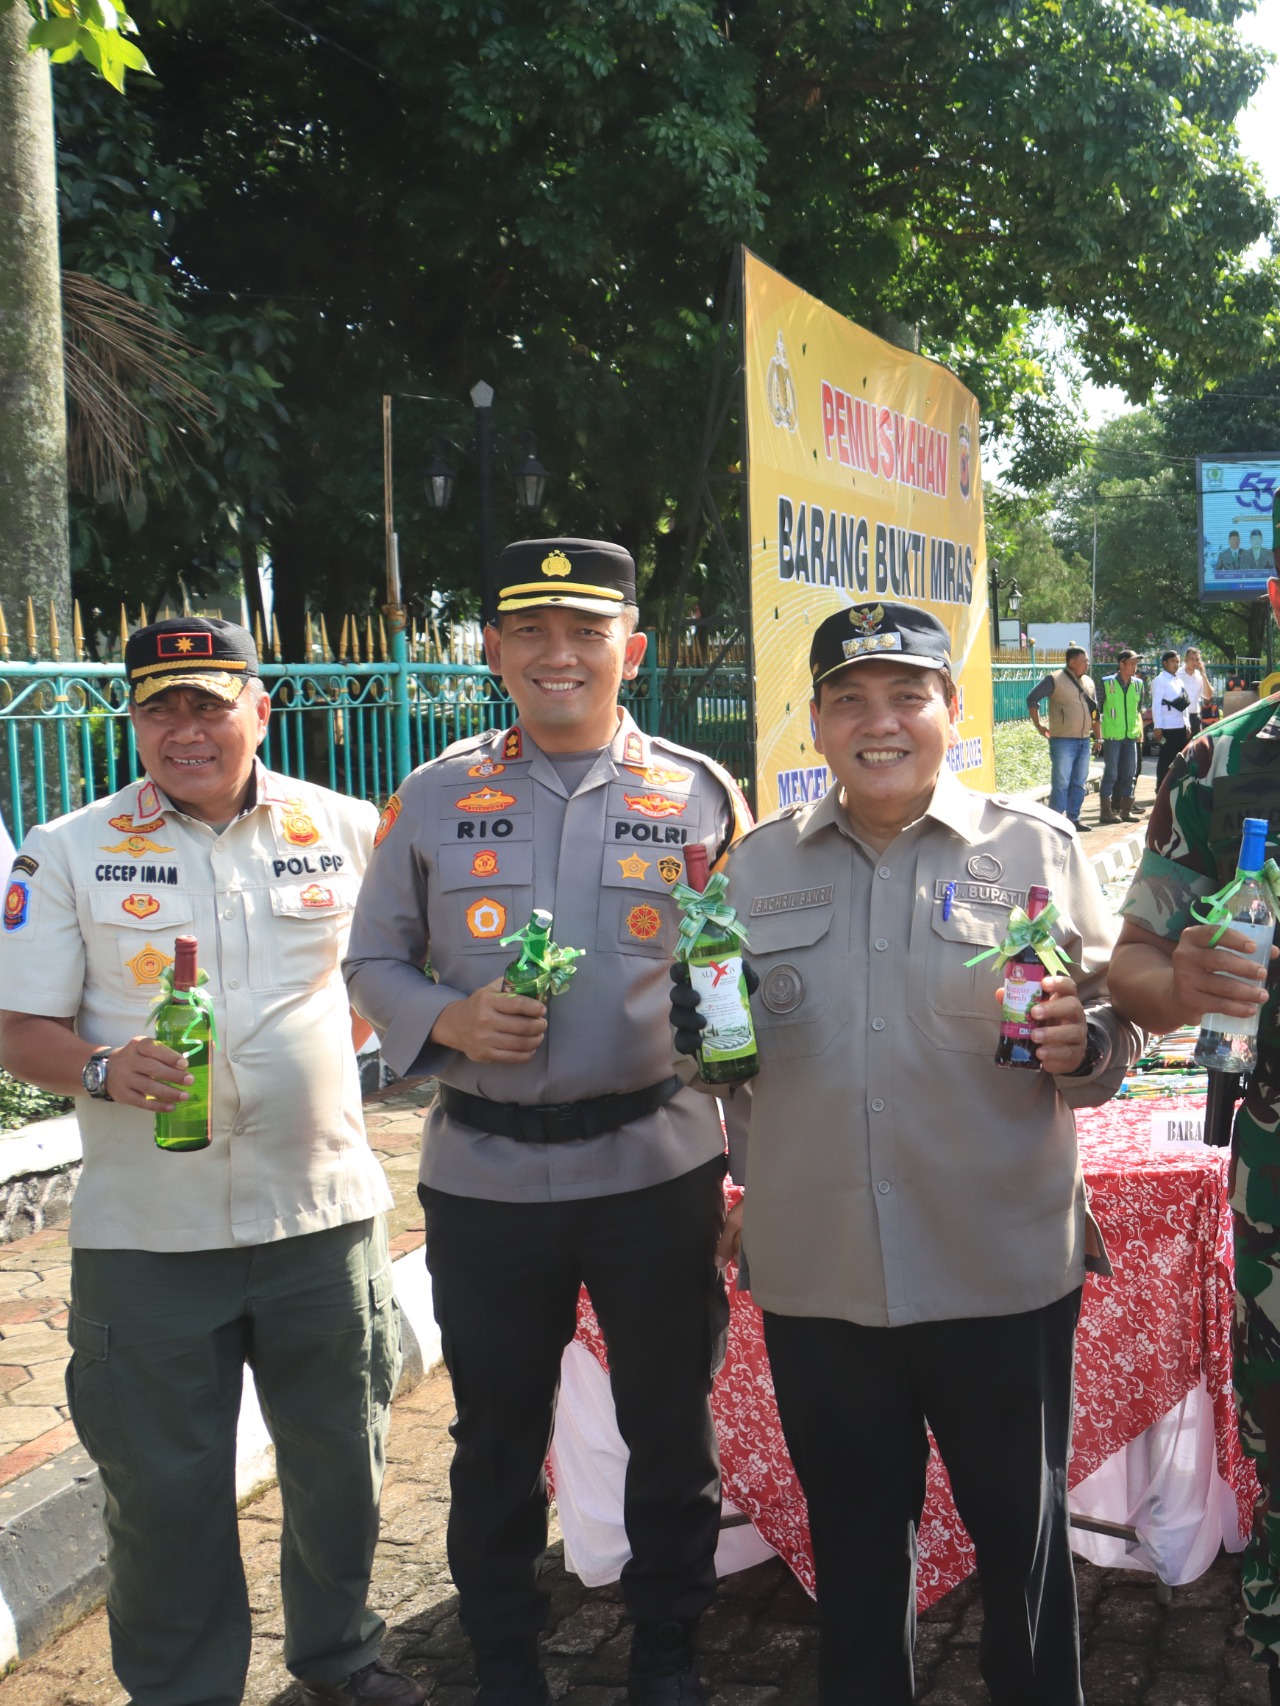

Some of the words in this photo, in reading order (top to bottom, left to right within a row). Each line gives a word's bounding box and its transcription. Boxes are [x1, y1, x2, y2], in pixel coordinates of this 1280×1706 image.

[821, 380, 949, 498] PEMUSNAHAN
[778, 495, 869, 594] BARANG
[875, 522, 927, 599] BUKTI
[930, 536, 973, 605] MIRAS
[965, 738, 982, 769] 2025
[457, 819, 513, 839] RIO
[615, 821, 688, 845] POLRI
[95, 864, 137, 882] CECEP
[140, 865, 178, 885] IMAM
[272, 856, 316, 878] POL
[320, 854, 344, 872] PP
[799, 888, 829, 905] BAKRI
[968, 886, 1023, 908] BUPATI
